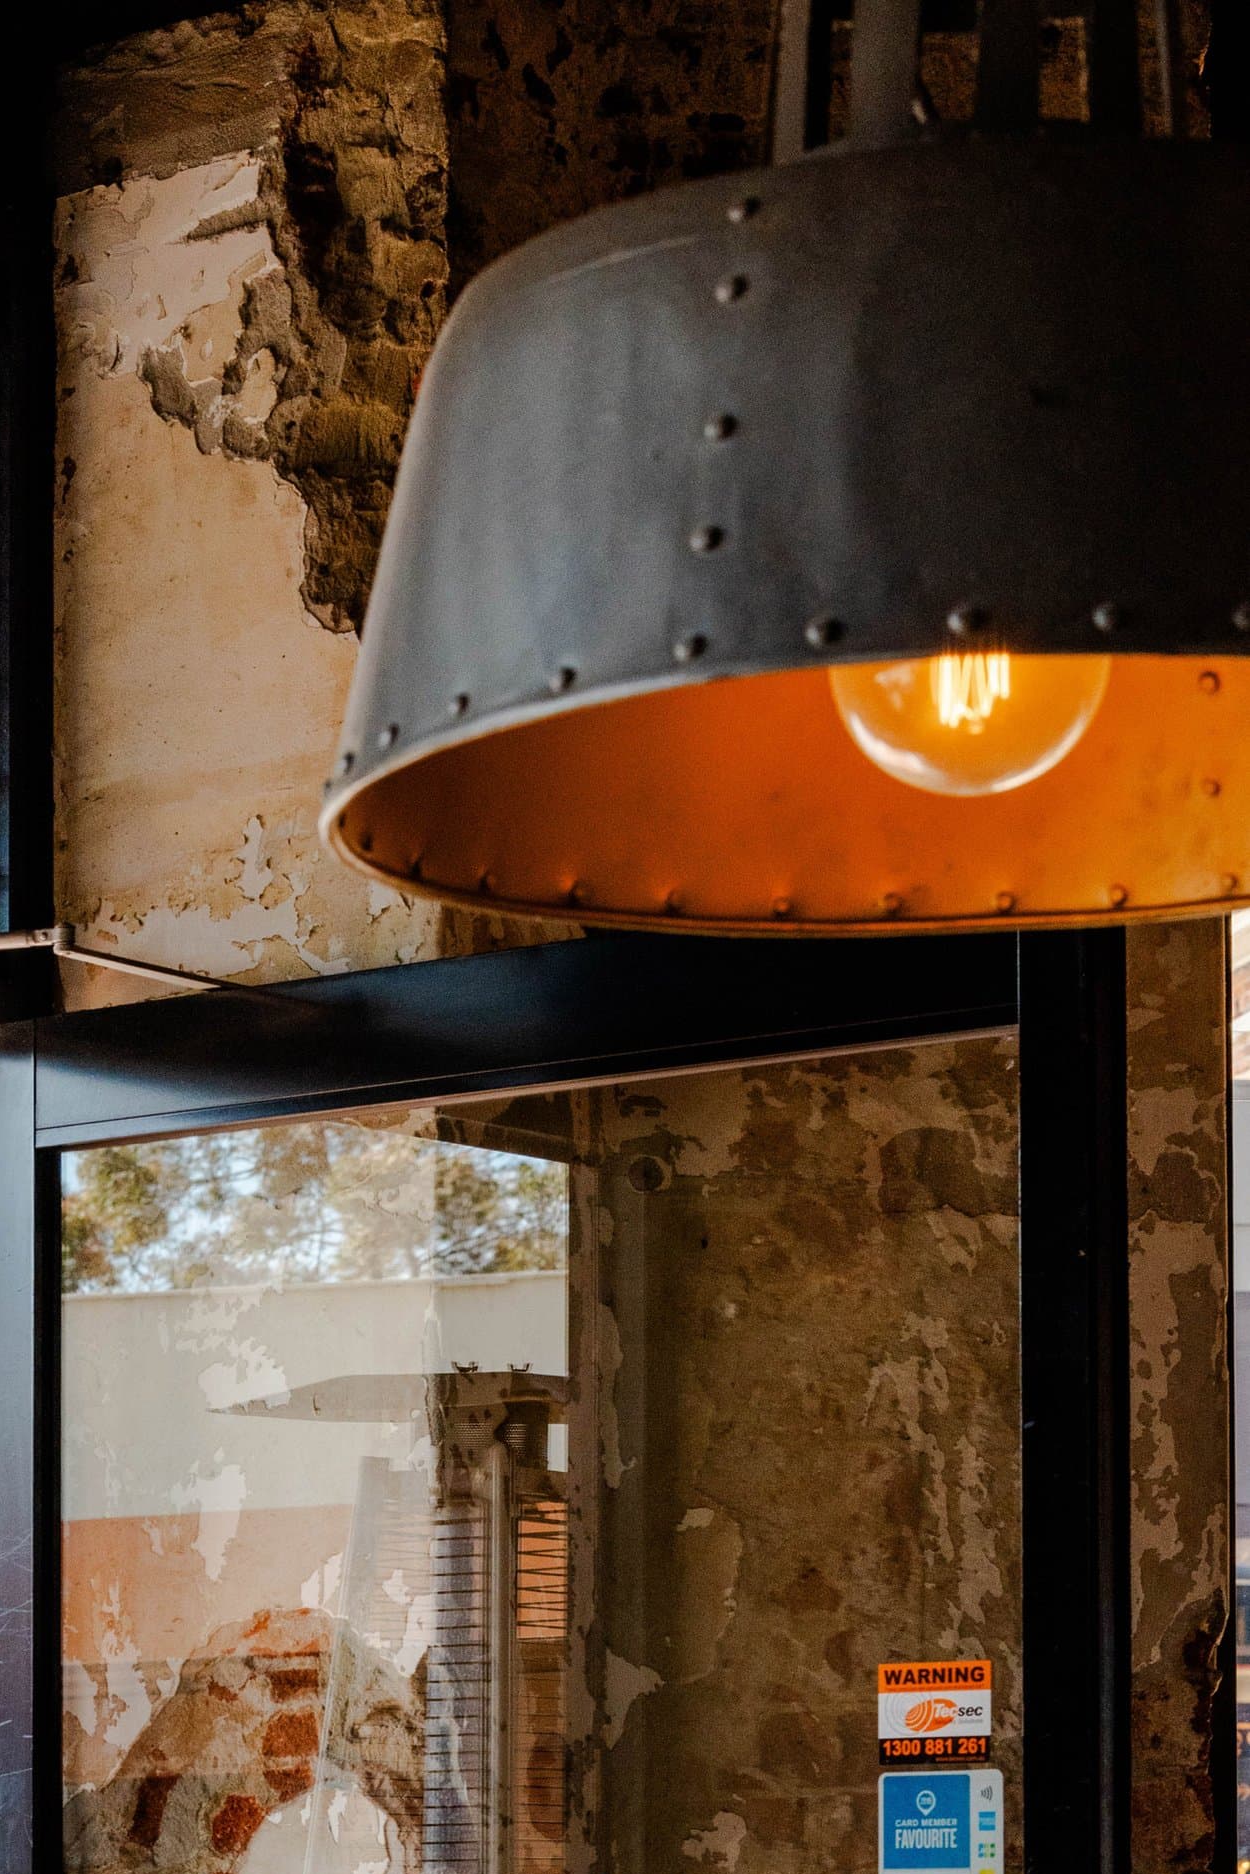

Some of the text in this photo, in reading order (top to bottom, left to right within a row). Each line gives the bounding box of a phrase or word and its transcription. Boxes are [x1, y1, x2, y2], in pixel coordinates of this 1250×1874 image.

[884, 1666, 985, 1686] WARNING
[883, 1738, 987, 1757] 1300 881 261
[895, 1818, 958, 1827] CARD MEMBER
[895, 1828, 958, 1849] FAVOURITE
